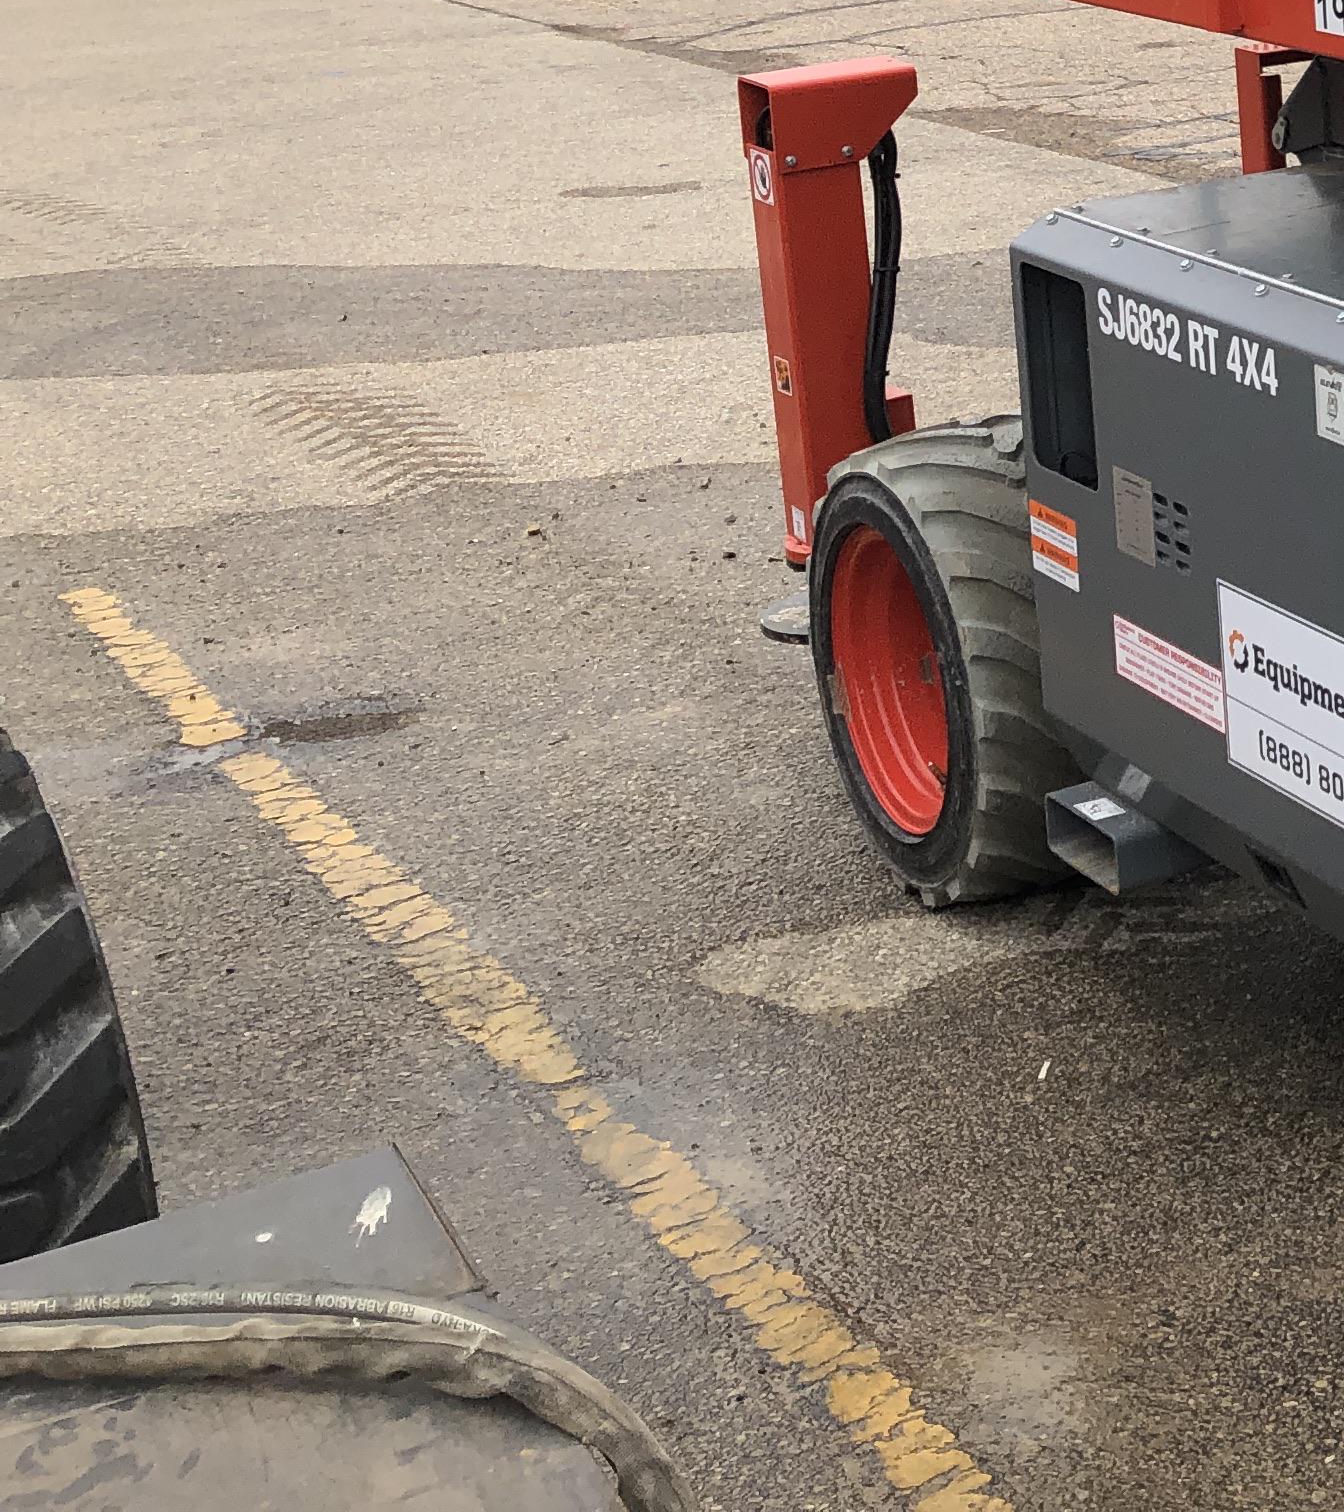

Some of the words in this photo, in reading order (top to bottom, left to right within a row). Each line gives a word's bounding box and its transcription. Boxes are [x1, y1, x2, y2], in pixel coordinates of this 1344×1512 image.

[1097, 288, 1182, 362] SJ6832
[1188, 320, 1218, 375] RT
[1226, 334, 1279, 396] 4X4
[1259, 729, 1311, 786] (888)
[10, 1297, 57, 1314] FLAME
[315, 1294, 391, 1314] ABRASION
